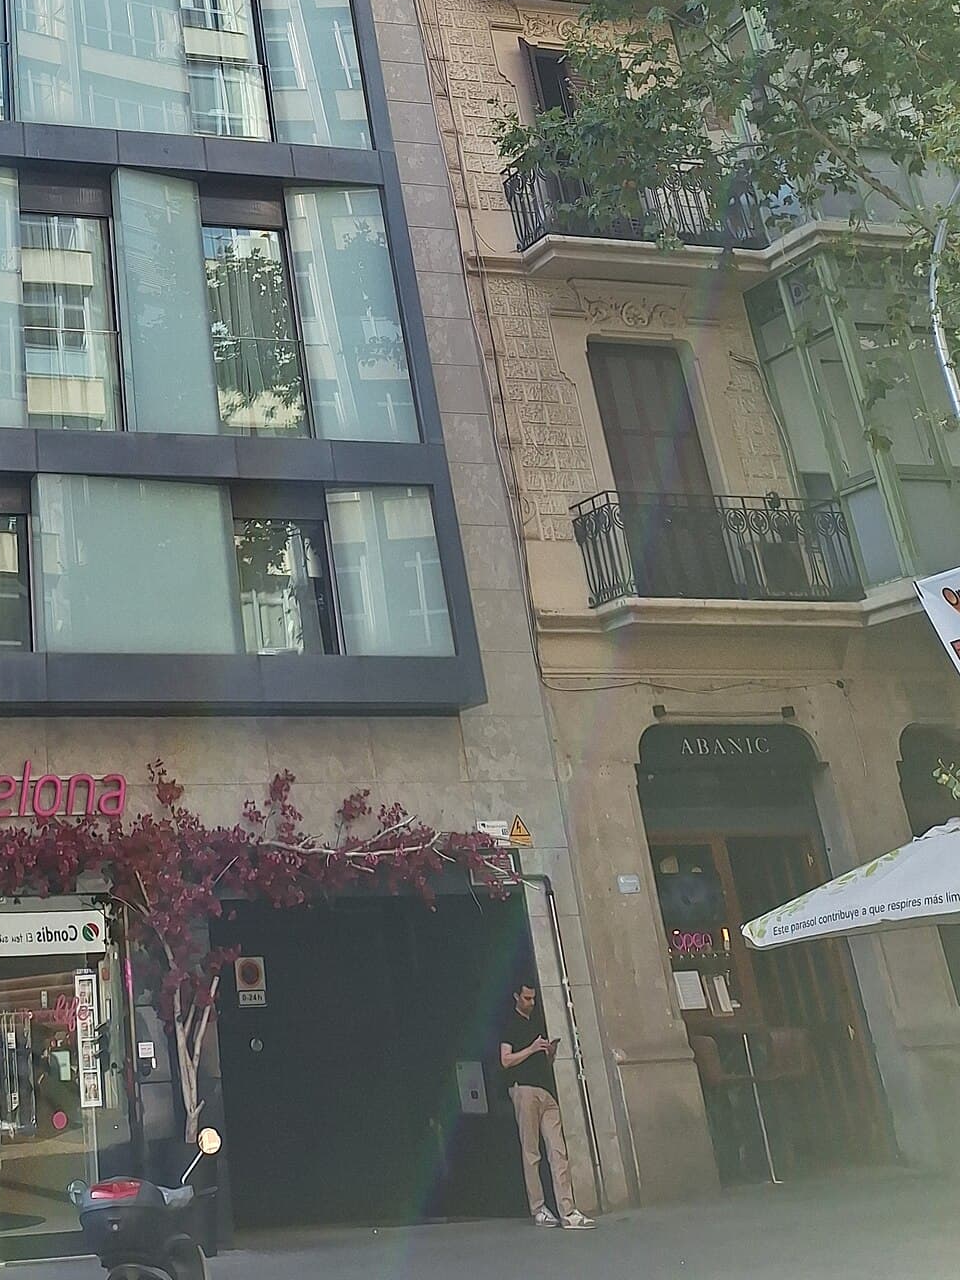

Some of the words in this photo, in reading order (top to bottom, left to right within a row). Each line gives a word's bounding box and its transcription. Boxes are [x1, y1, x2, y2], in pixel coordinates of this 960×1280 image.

[681, 737, 770, 755] ABANIC
[772, 924, 790, 936] Este
[790, 916, 818, 932] parasol
[818, 907, 860, 925] contribuye
[861, 907, 868, 916] a
[868, 903, 886, 917] que
[887, 897, 922, 914] respires
[924, 892, 944, 905] más
